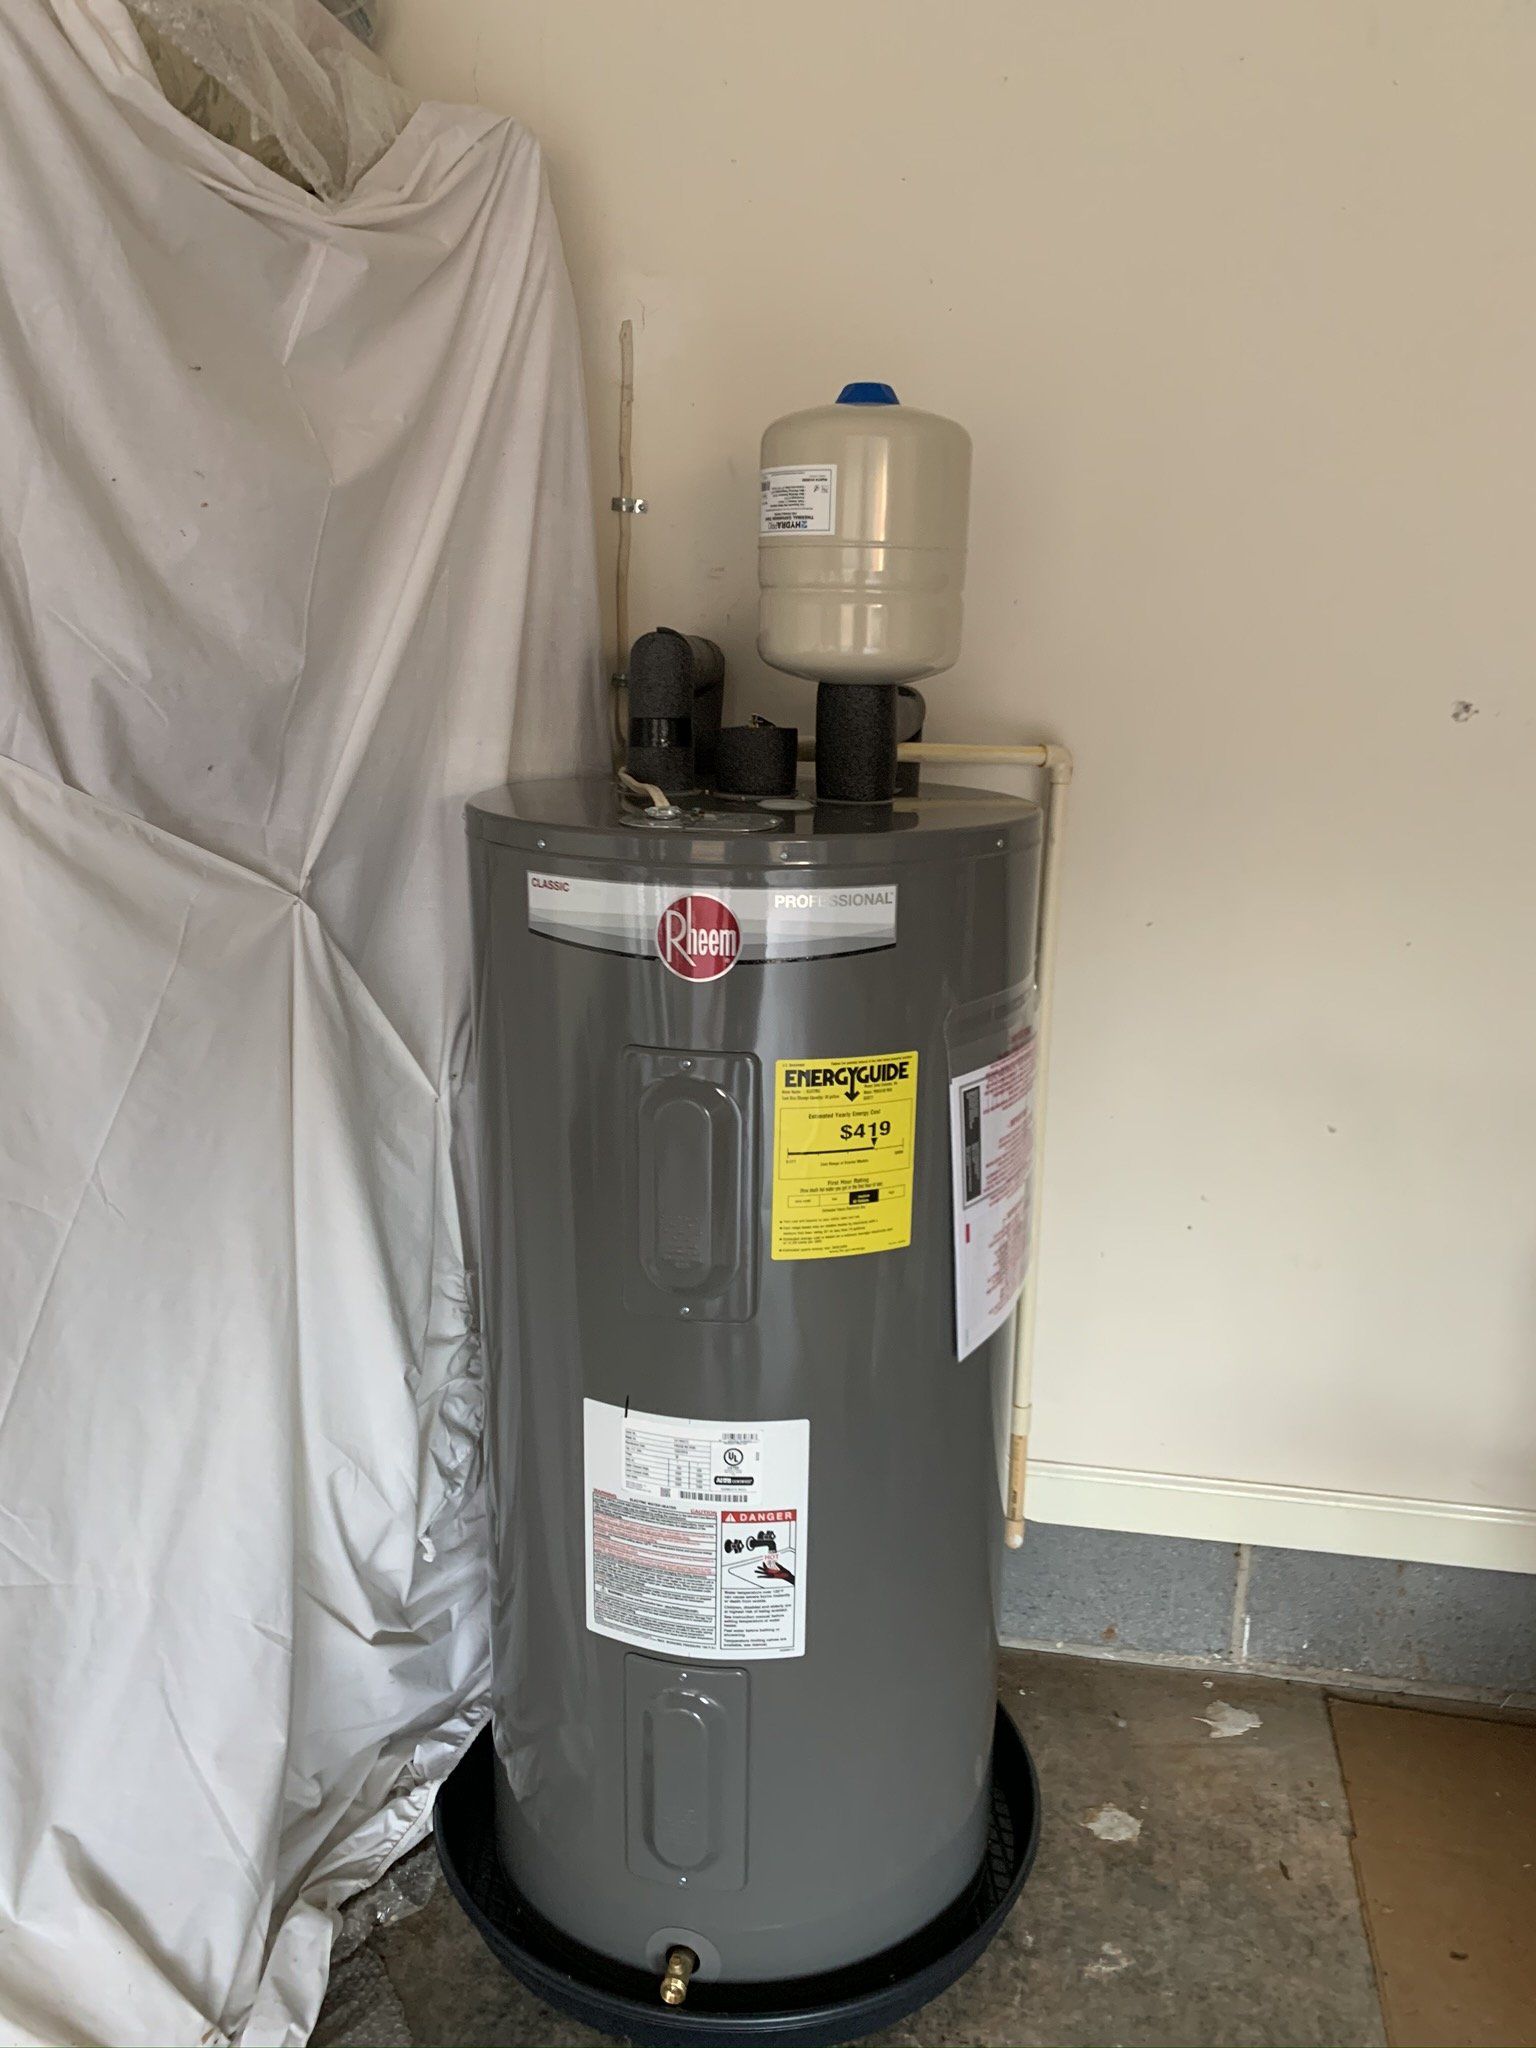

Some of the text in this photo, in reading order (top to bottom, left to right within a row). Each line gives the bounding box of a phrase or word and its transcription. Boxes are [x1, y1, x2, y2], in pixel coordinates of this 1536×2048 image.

[531, 878, 570, 892] CLASSIC
[665, 897, 737, 966] Rheem
[785, 1062, 909, 1089] ENERGYGUIDE
[840, 1121, 891, 1141] $419
[740, 1512, 792, 1521] DANGER
